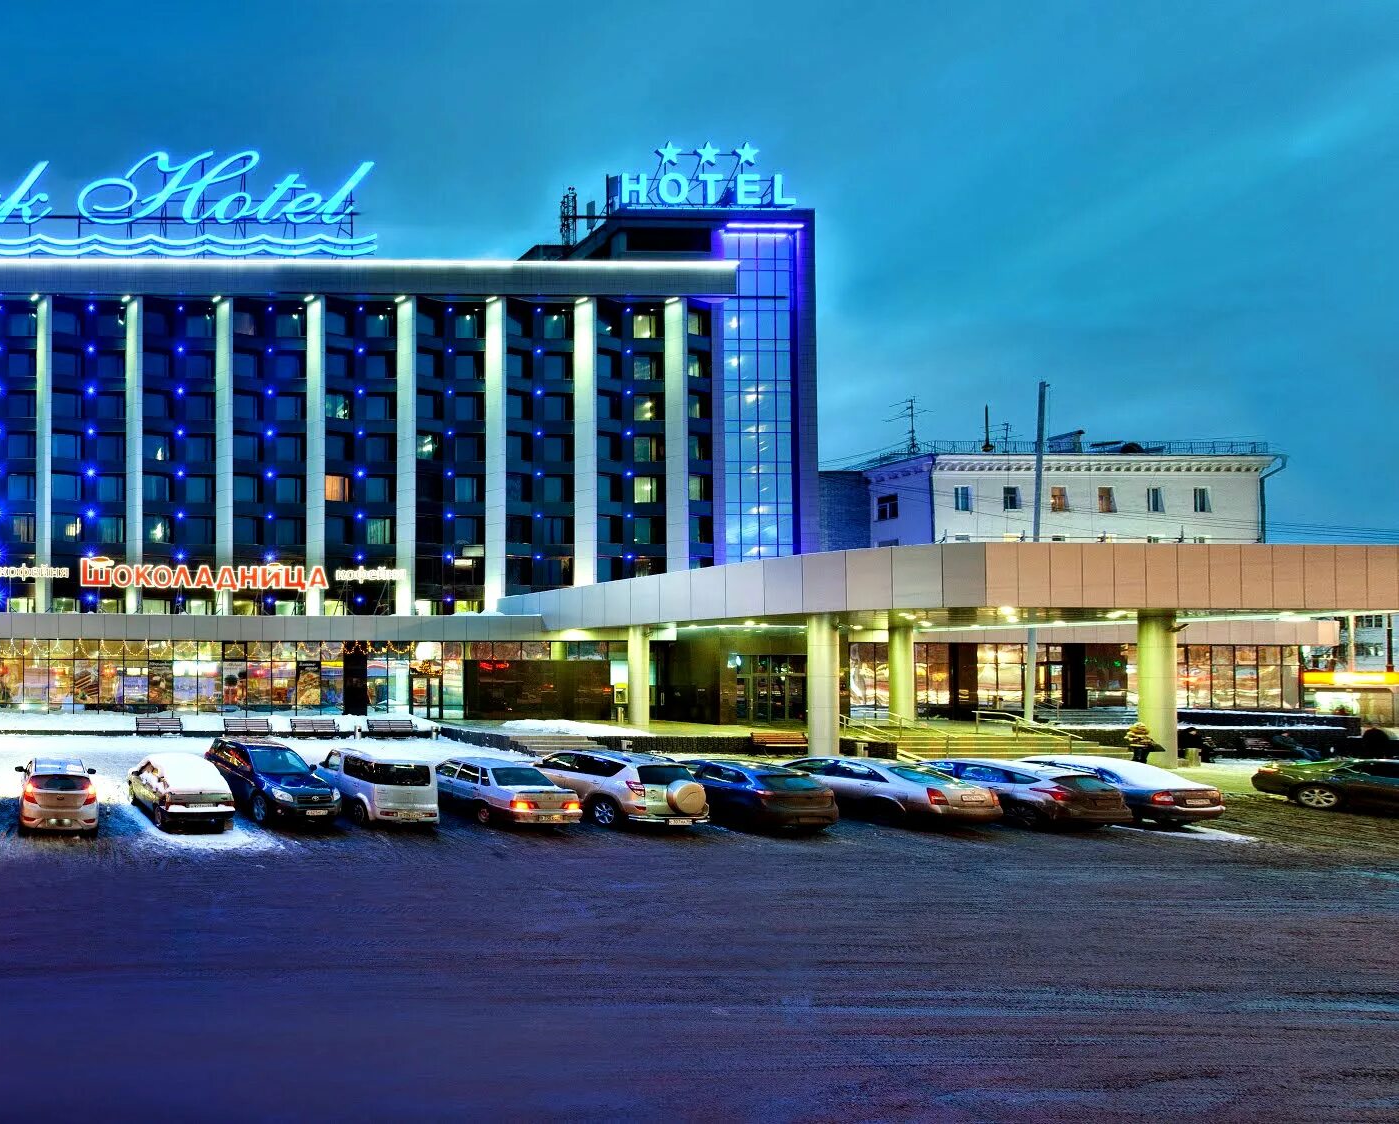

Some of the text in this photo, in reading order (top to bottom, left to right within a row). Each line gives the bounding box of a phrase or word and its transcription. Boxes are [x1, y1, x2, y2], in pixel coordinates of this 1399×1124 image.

[78, 151, 375, 224] Hotel
[620, 172, 797, 205] HOTEL
[80, 557, 329, 592] ШОКОЛАДНИЦА
[335, 565, 406, 584] кофейня
